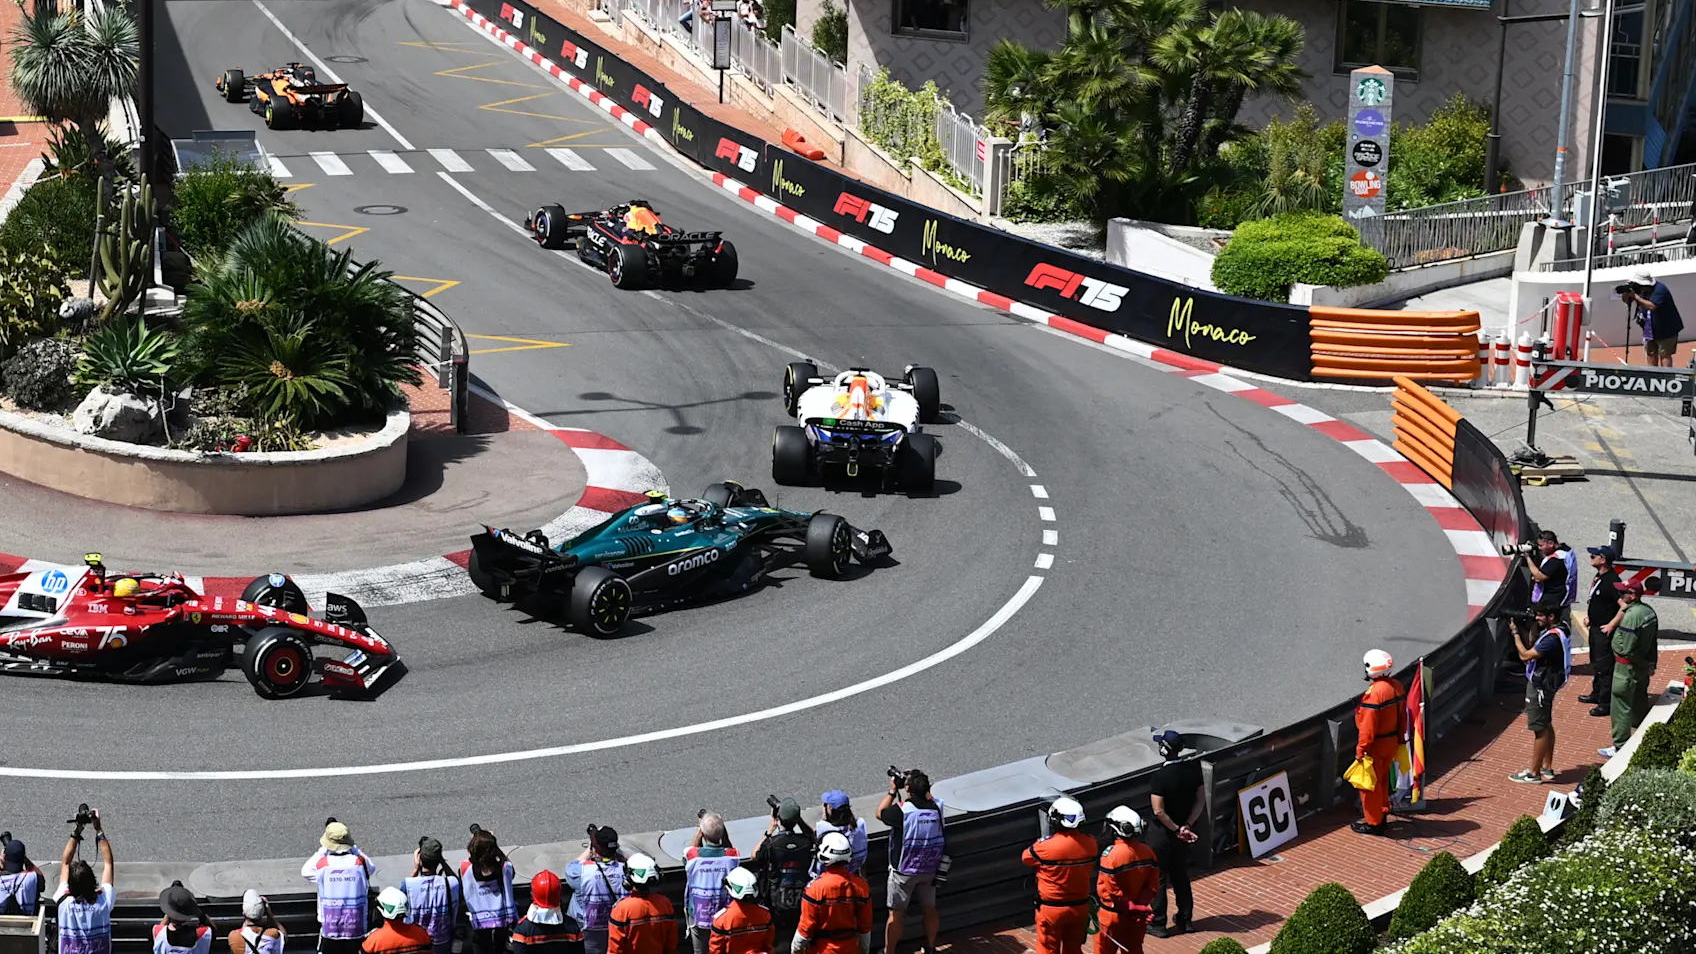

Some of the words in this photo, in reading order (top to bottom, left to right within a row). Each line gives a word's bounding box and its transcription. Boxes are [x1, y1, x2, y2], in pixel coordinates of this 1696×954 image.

[772, 159, 805, 200] Monaco
[658, 231, 716, 241] ORACLE
[922, 219, 971, 266] Monaco
[1167, 297, 1256, 349] Monaco
[1585, 374, 1683, 394] PIOVANO
[866, 421, 885, 429] App
[500, 532, 544, 554] Valvoline
[668, 549, 719, 576] aramco
[43, 571, 68, 593] hp
[1670, 576, 1696, 594] PI
[88, 604, 109, 614] IBM
[327, 603, 347, 612] aws
[61, 641, 88, 650] PERONI
[1247, 785, 1289, 844] SC
